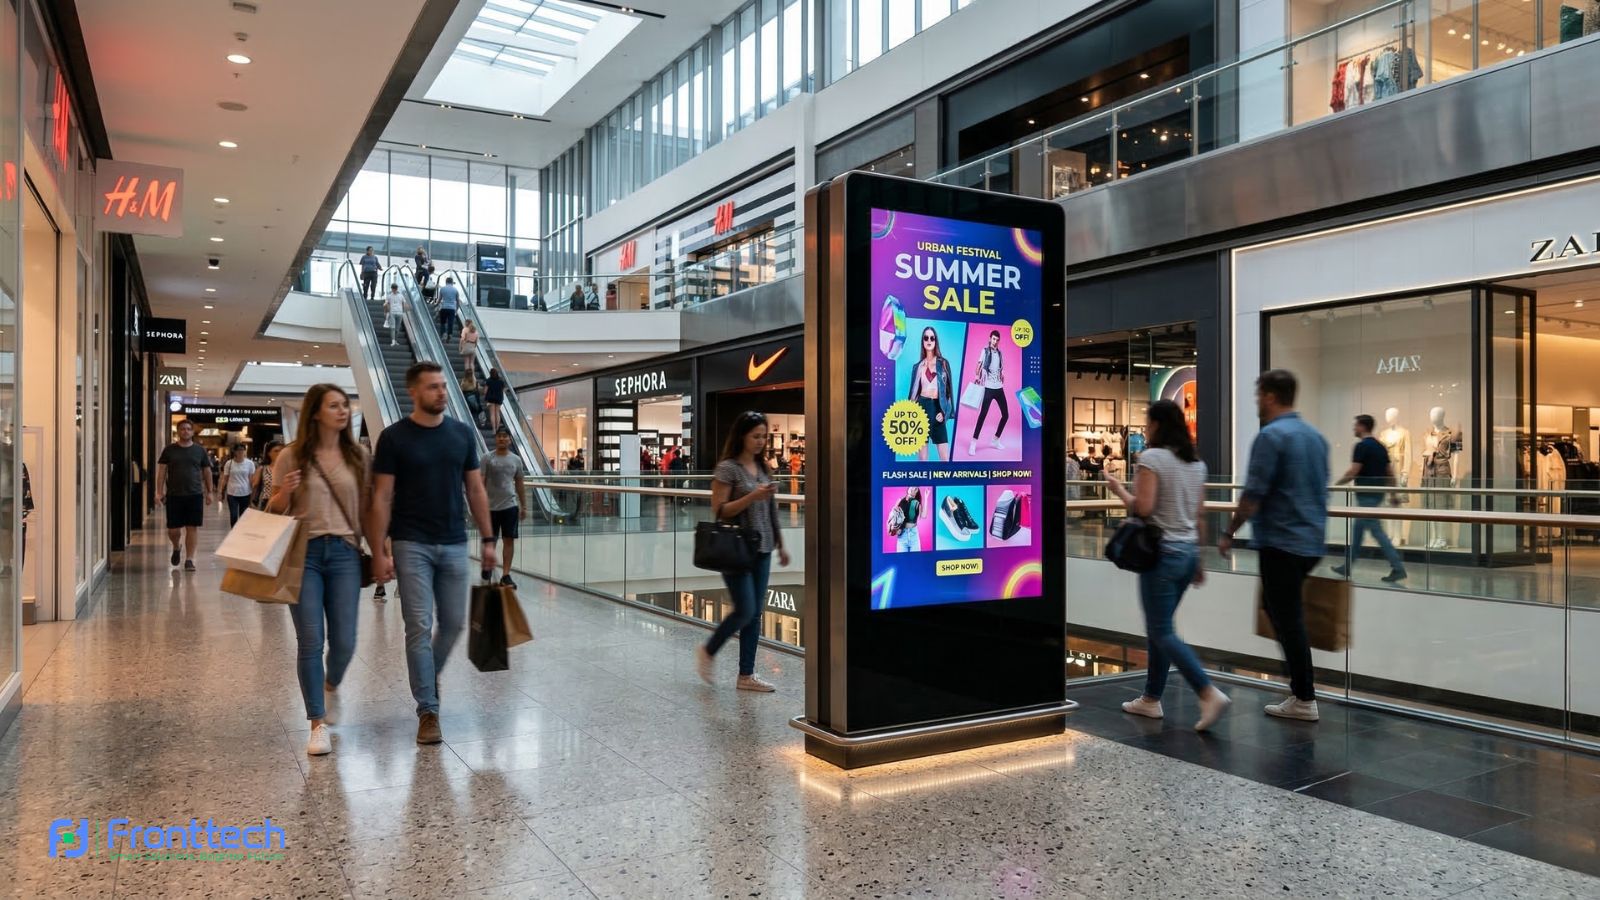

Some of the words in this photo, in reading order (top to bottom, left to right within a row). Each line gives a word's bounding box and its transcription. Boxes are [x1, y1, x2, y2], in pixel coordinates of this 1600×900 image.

[104, 175, 177, 222] H&M
[917, 241, 954, 254] URBAN
[956, 246, 1002, 260] FESTIVAL
[895, 253, 1021, 290] SUMMER
[923, 285, 995, 315] SALE
[146, 331, 184, 339] SEPHORA
[159, 374, 185, 386] ZARA
[615, 370, 667, 397] SEPHORA
[907, 411, 918, 419] TO
[889, 420, 924, 435] 50%
[895, 436, 917, 446] OFF!
[882, 471, 907, 479] FLASH
[908, 471, 928, 479] SALE
[933, 471, 952, 479] NEW
[952, 470, 988, 478] ARRIVALS
[992, 470, 1012, 478] SHOP
[941, 564, 960, 572] SHOP
[767, 589, 797, 612] ZARA
